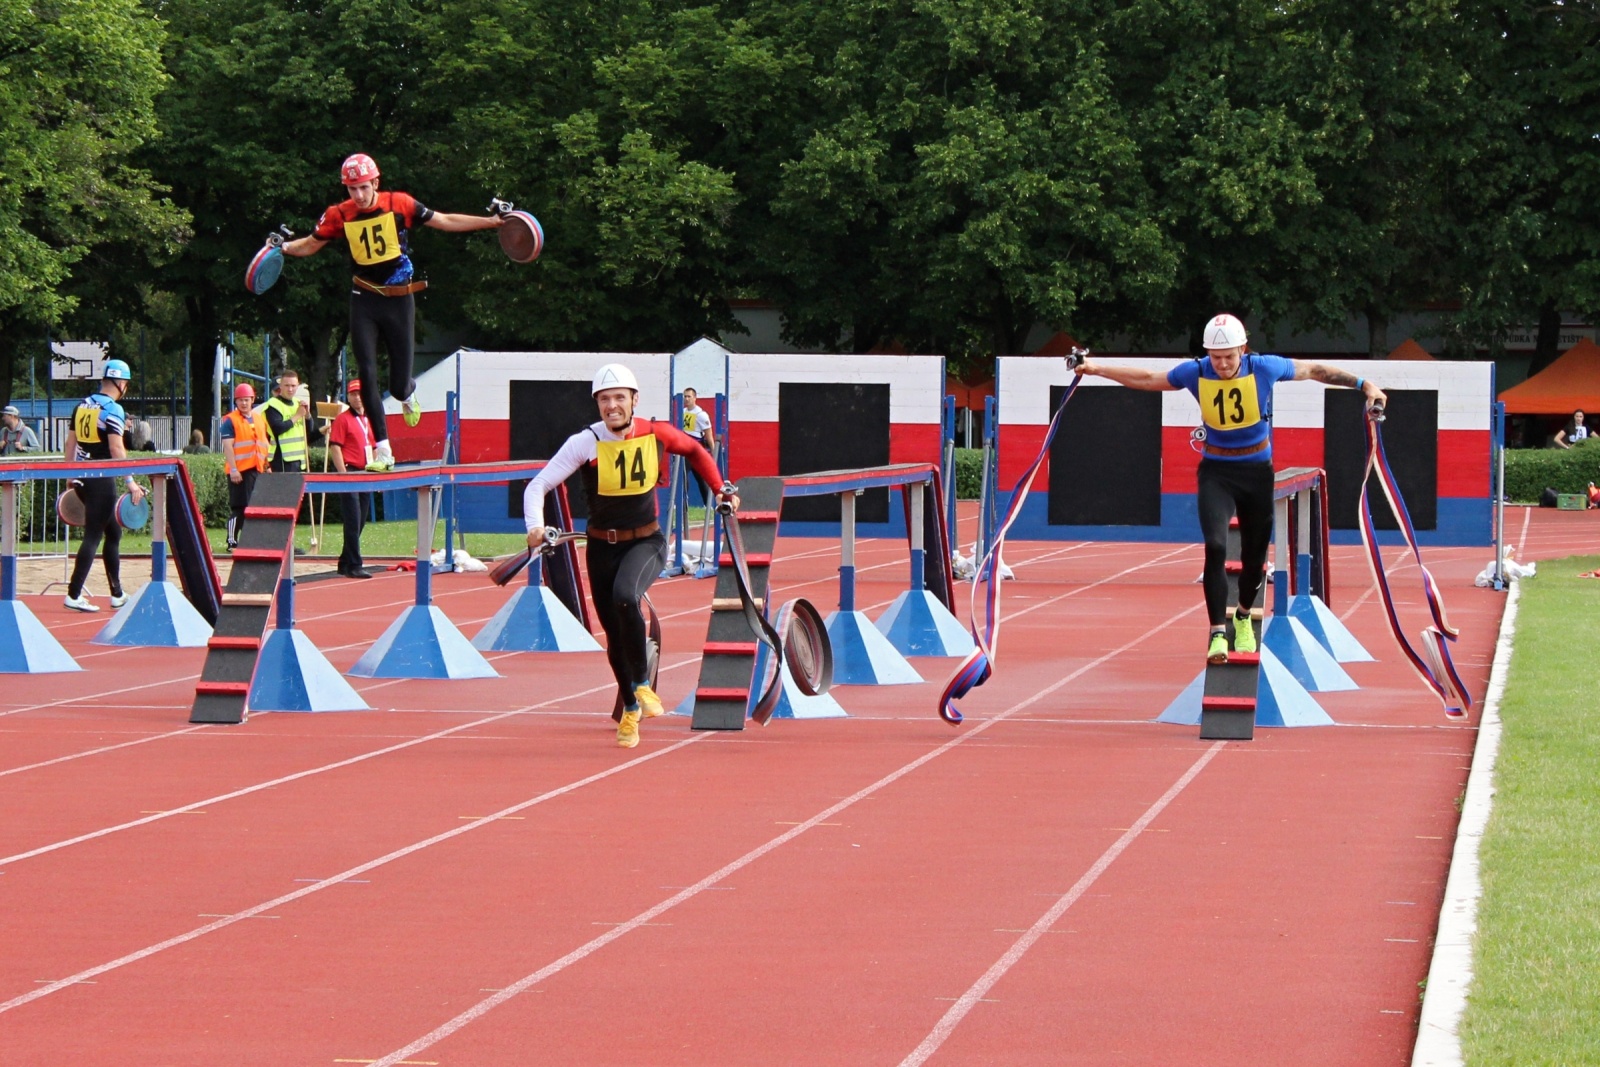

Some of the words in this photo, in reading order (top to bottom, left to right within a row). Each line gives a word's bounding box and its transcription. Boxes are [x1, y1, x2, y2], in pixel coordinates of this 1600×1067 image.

[359, 223, 387, 260] 15
[1213, 387, 1245, 425] 13
[79, 413, 91, 438] 18
[614, 446, 647, 490] 14
